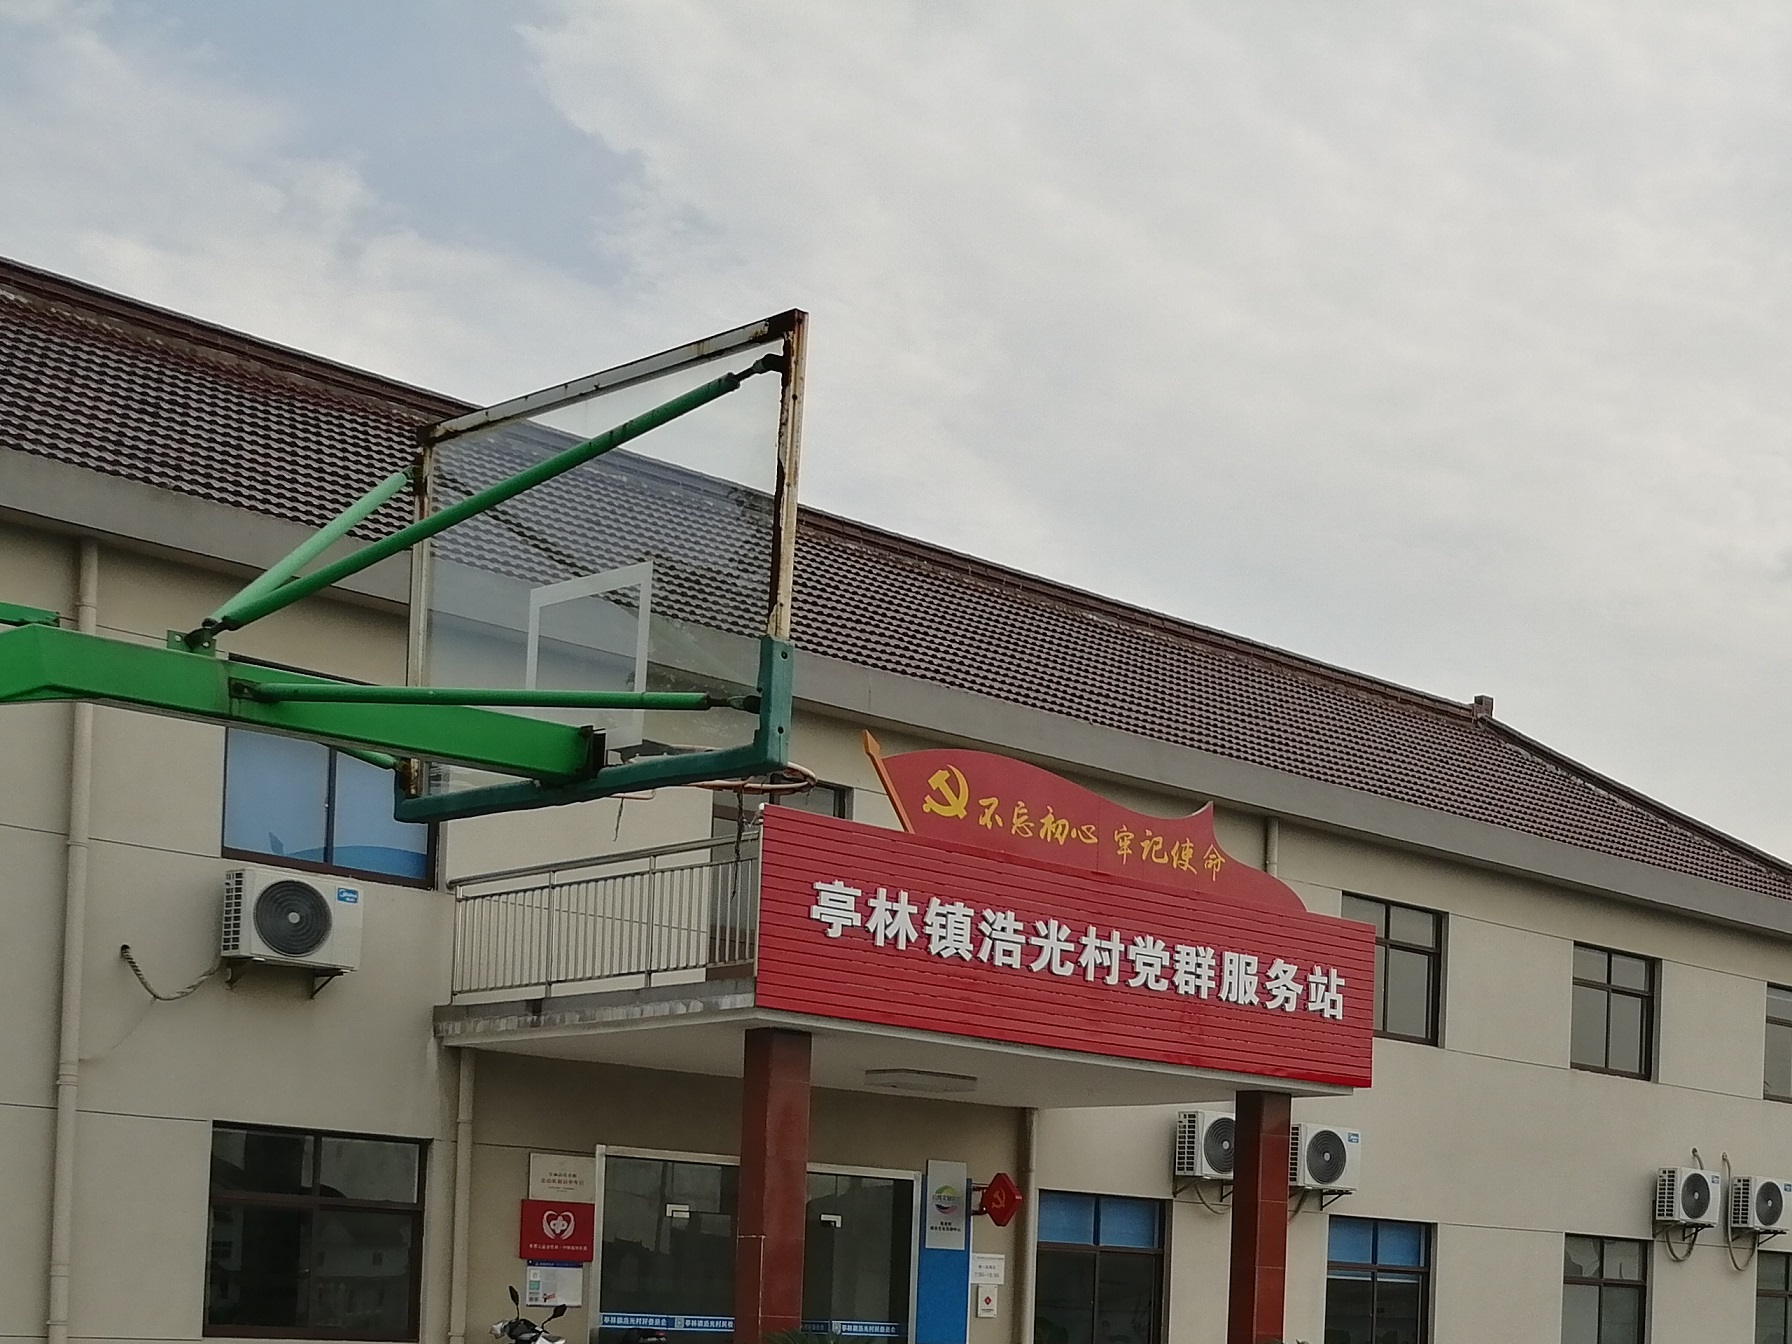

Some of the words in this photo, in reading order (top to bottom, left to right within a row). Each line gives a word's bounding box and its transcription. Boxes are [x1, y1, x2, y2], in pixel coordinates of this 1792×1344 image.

[978, 797, 1099, 846] 不忘初心
[1114, 824, 1227, 882] 牢记使命
[811, 879, 1346, 1020] 亭林镇浩光村党群服务站
